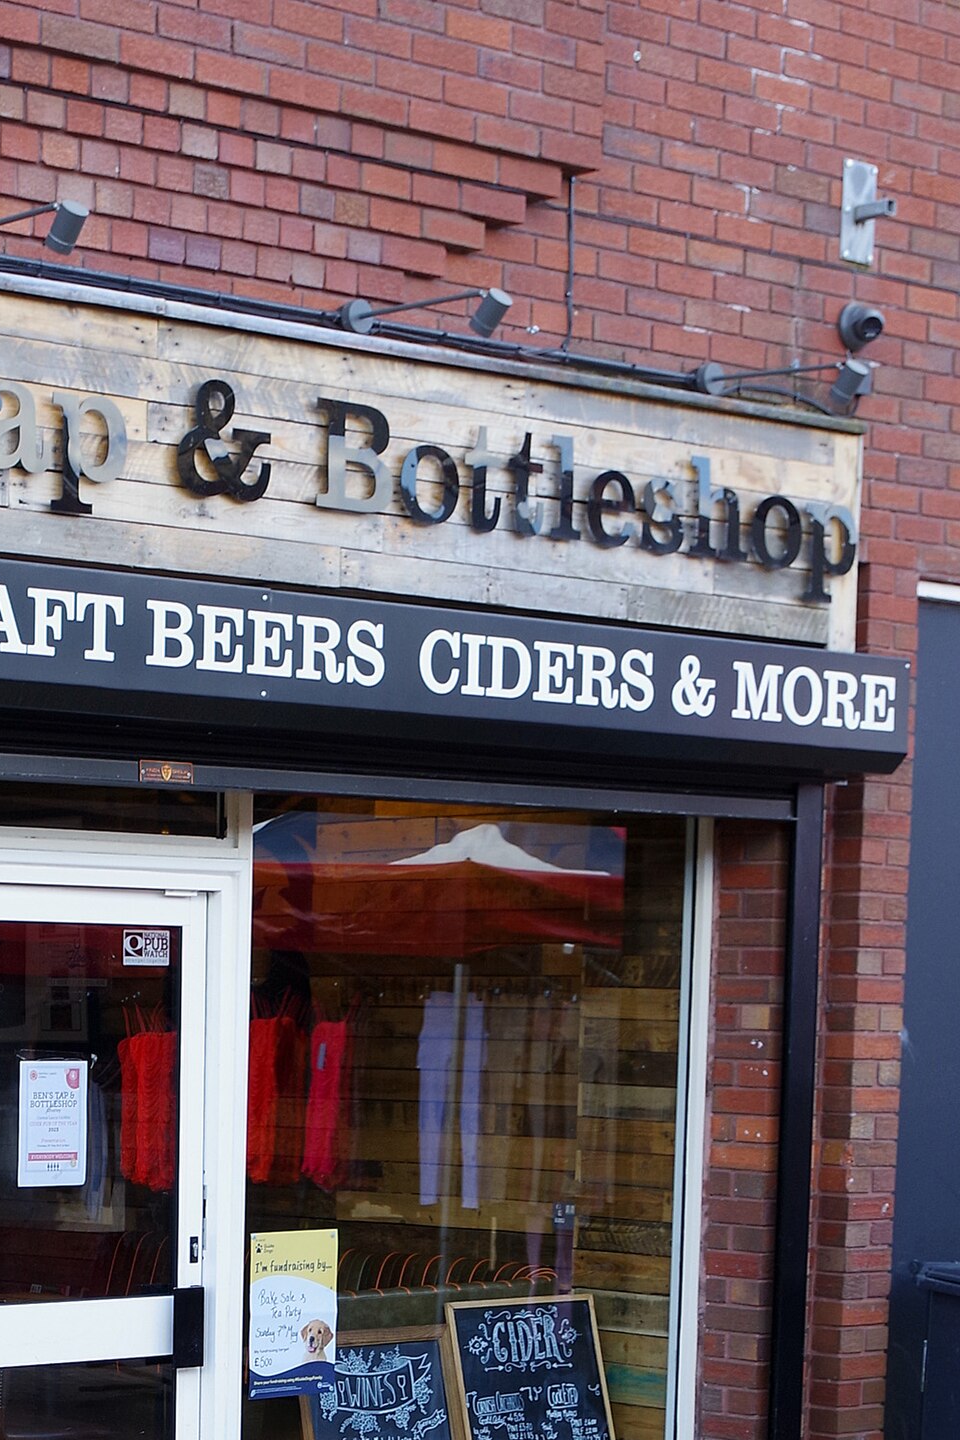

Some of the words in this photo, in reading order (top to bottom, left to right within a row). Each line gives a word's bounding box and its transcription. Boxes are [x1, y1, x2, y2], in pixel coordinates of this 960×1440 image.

[178, 379, 271, 502] &
[315, 397, 856, 602] Bottleshop
[145, 600, 385, 688] BEERS
[420, 630, 655, 713] CIDERS
[672, 655, 716, 718] &
[732, 660, 897, 732] MORE
[144, 937, 168, 950] PUB
[144, 950, 168, 958] WATCH
[33, 1092, 53, 1100] BEN'S
[55, 1092, 69, 1100] TAP
[30, 1100, 78, 1108] BOTTLESHOP
[255, 1261, 268, 1274] I'm
[270, 1259, 315, 1273] fundraising
[492, 1315, 561, 1364] CIDER
[346, 1374, 397, 1409] WINES
